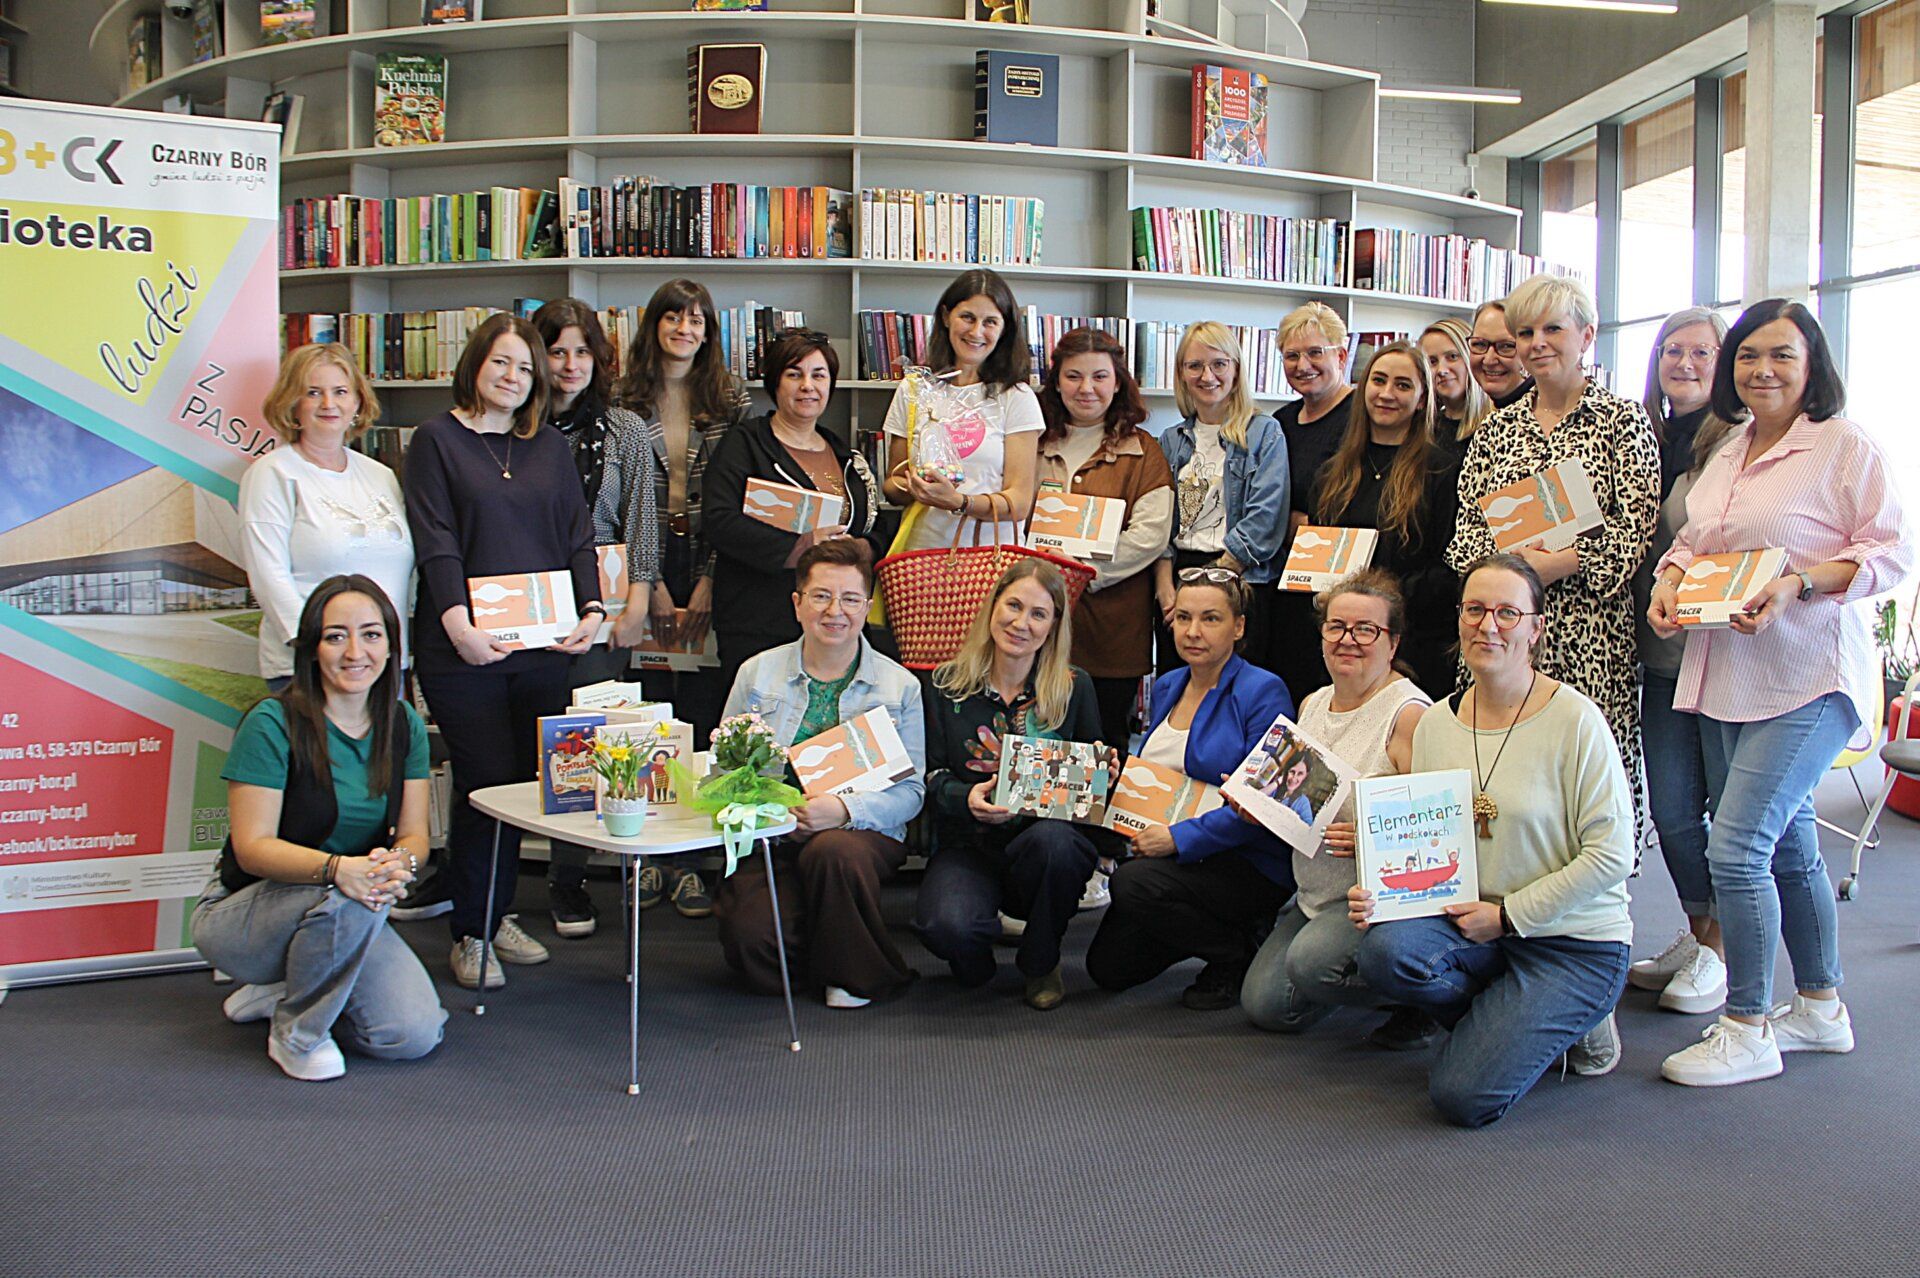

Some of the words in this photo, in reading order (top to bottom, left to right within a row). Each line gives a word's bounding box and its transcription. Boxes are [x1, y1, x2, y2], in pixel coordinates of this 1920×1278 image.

[380, 67, 442, 82] Kuchnia
[388, 81, 434, 97] Polska
[1224, 85, 1246, 97] 1000
[151, 143, 223, 167] CZARNY
[230, 150, 267, 172] BÓR
[192, 170, 222, 182] ludzi
[0, 208, 153, 252] ioteka
[99, 260, 199, 394] ludzi
[196, 362, 225, 393] Z
[1034, 537, 1063, 547] SPACER
[1286, 574, 1312, 583] SPACER
[639, 655, 669, 663] SPACER
[1, 713, 19, 728] 42
[48, 740, 92, 758] 58-379
[93, 739, 137, 757] Czarny
[139, 736, 162, 753] Bór
[1053, 781, 1084, 792] SPACER
[1113, 813, 1146, 830] SPACER
[1367, 803, 1463, 835] Elementarz
[1385, 833, 1393, 842] w
[1397, 827, 1450, 843] podskokach
[83, 871, 112, 880] Kultury
